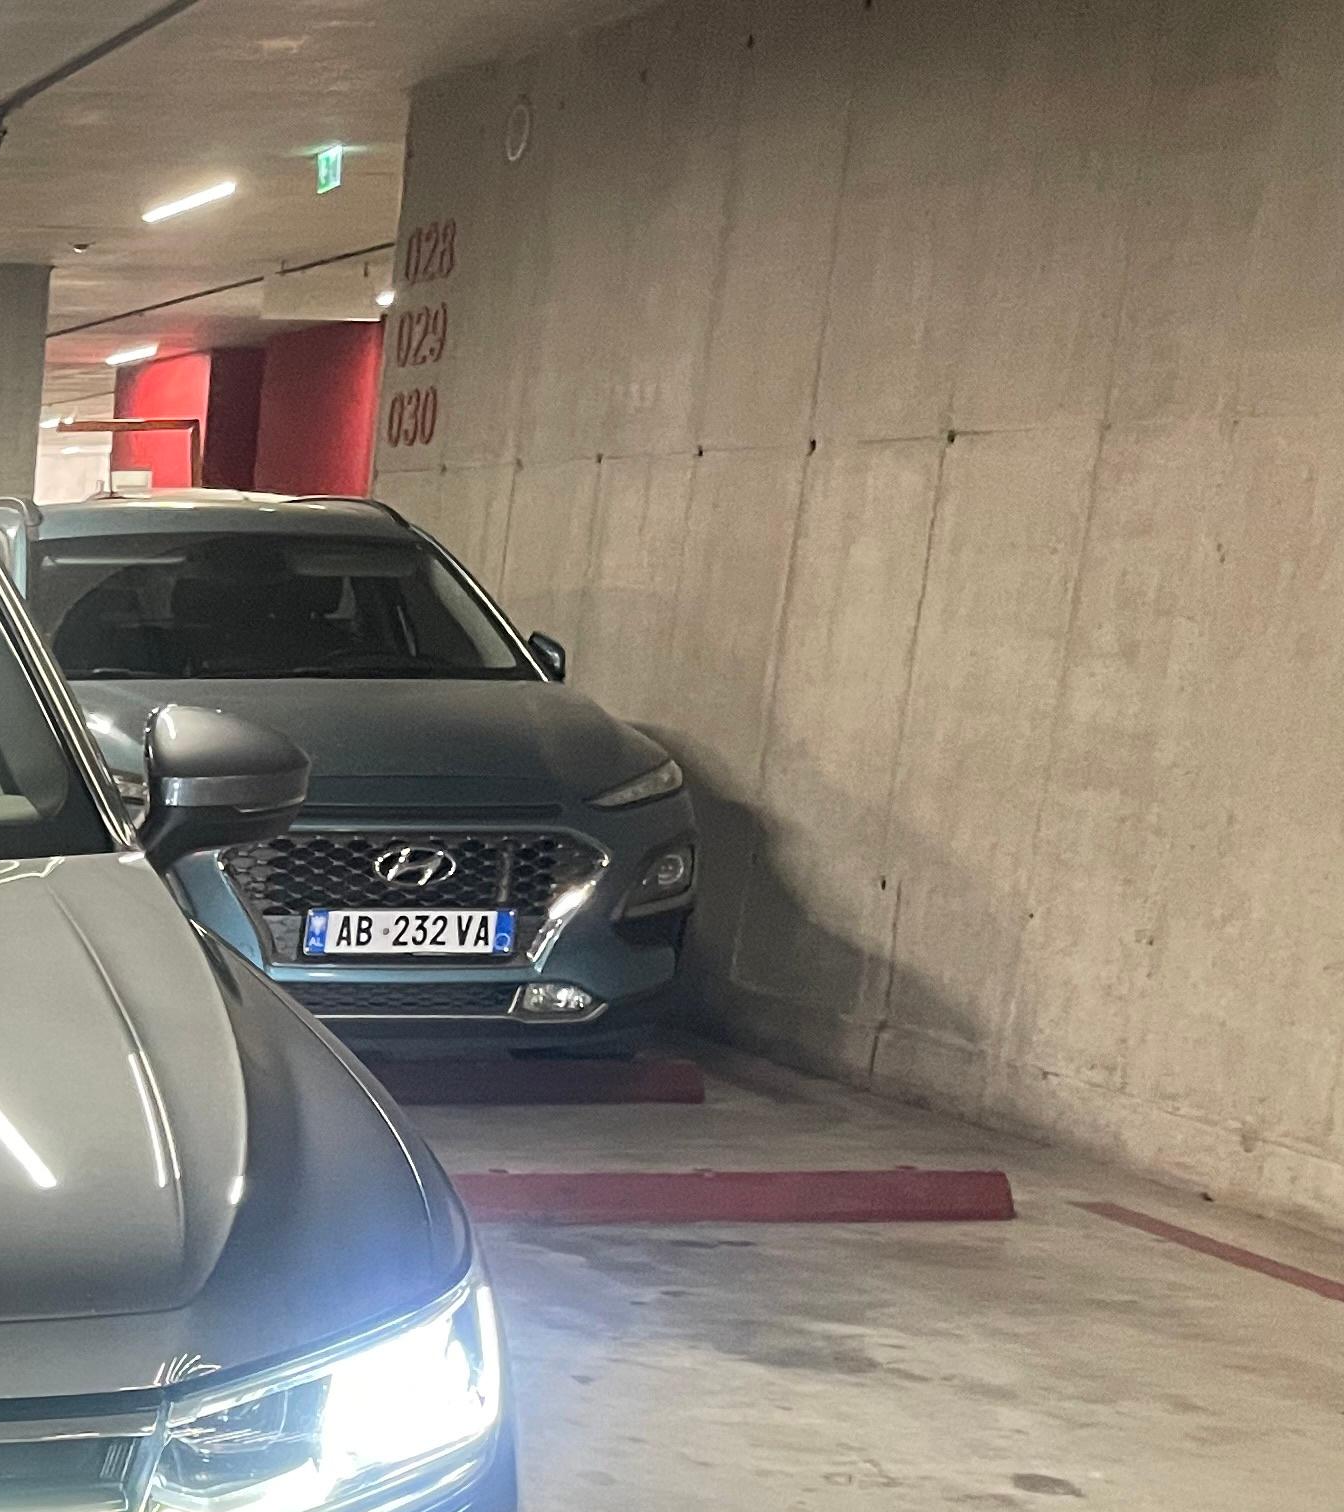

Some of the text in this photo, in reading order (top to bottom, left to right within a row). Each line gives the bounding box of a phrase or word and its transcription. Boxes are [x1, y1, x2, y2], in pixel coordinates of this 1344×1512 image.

[405, 218, 457, 284] 028
[397, 302, 448, 368] 029
[387, 386, 438, 448] 030
[335, 915, 490, 947] AB 232 VA
